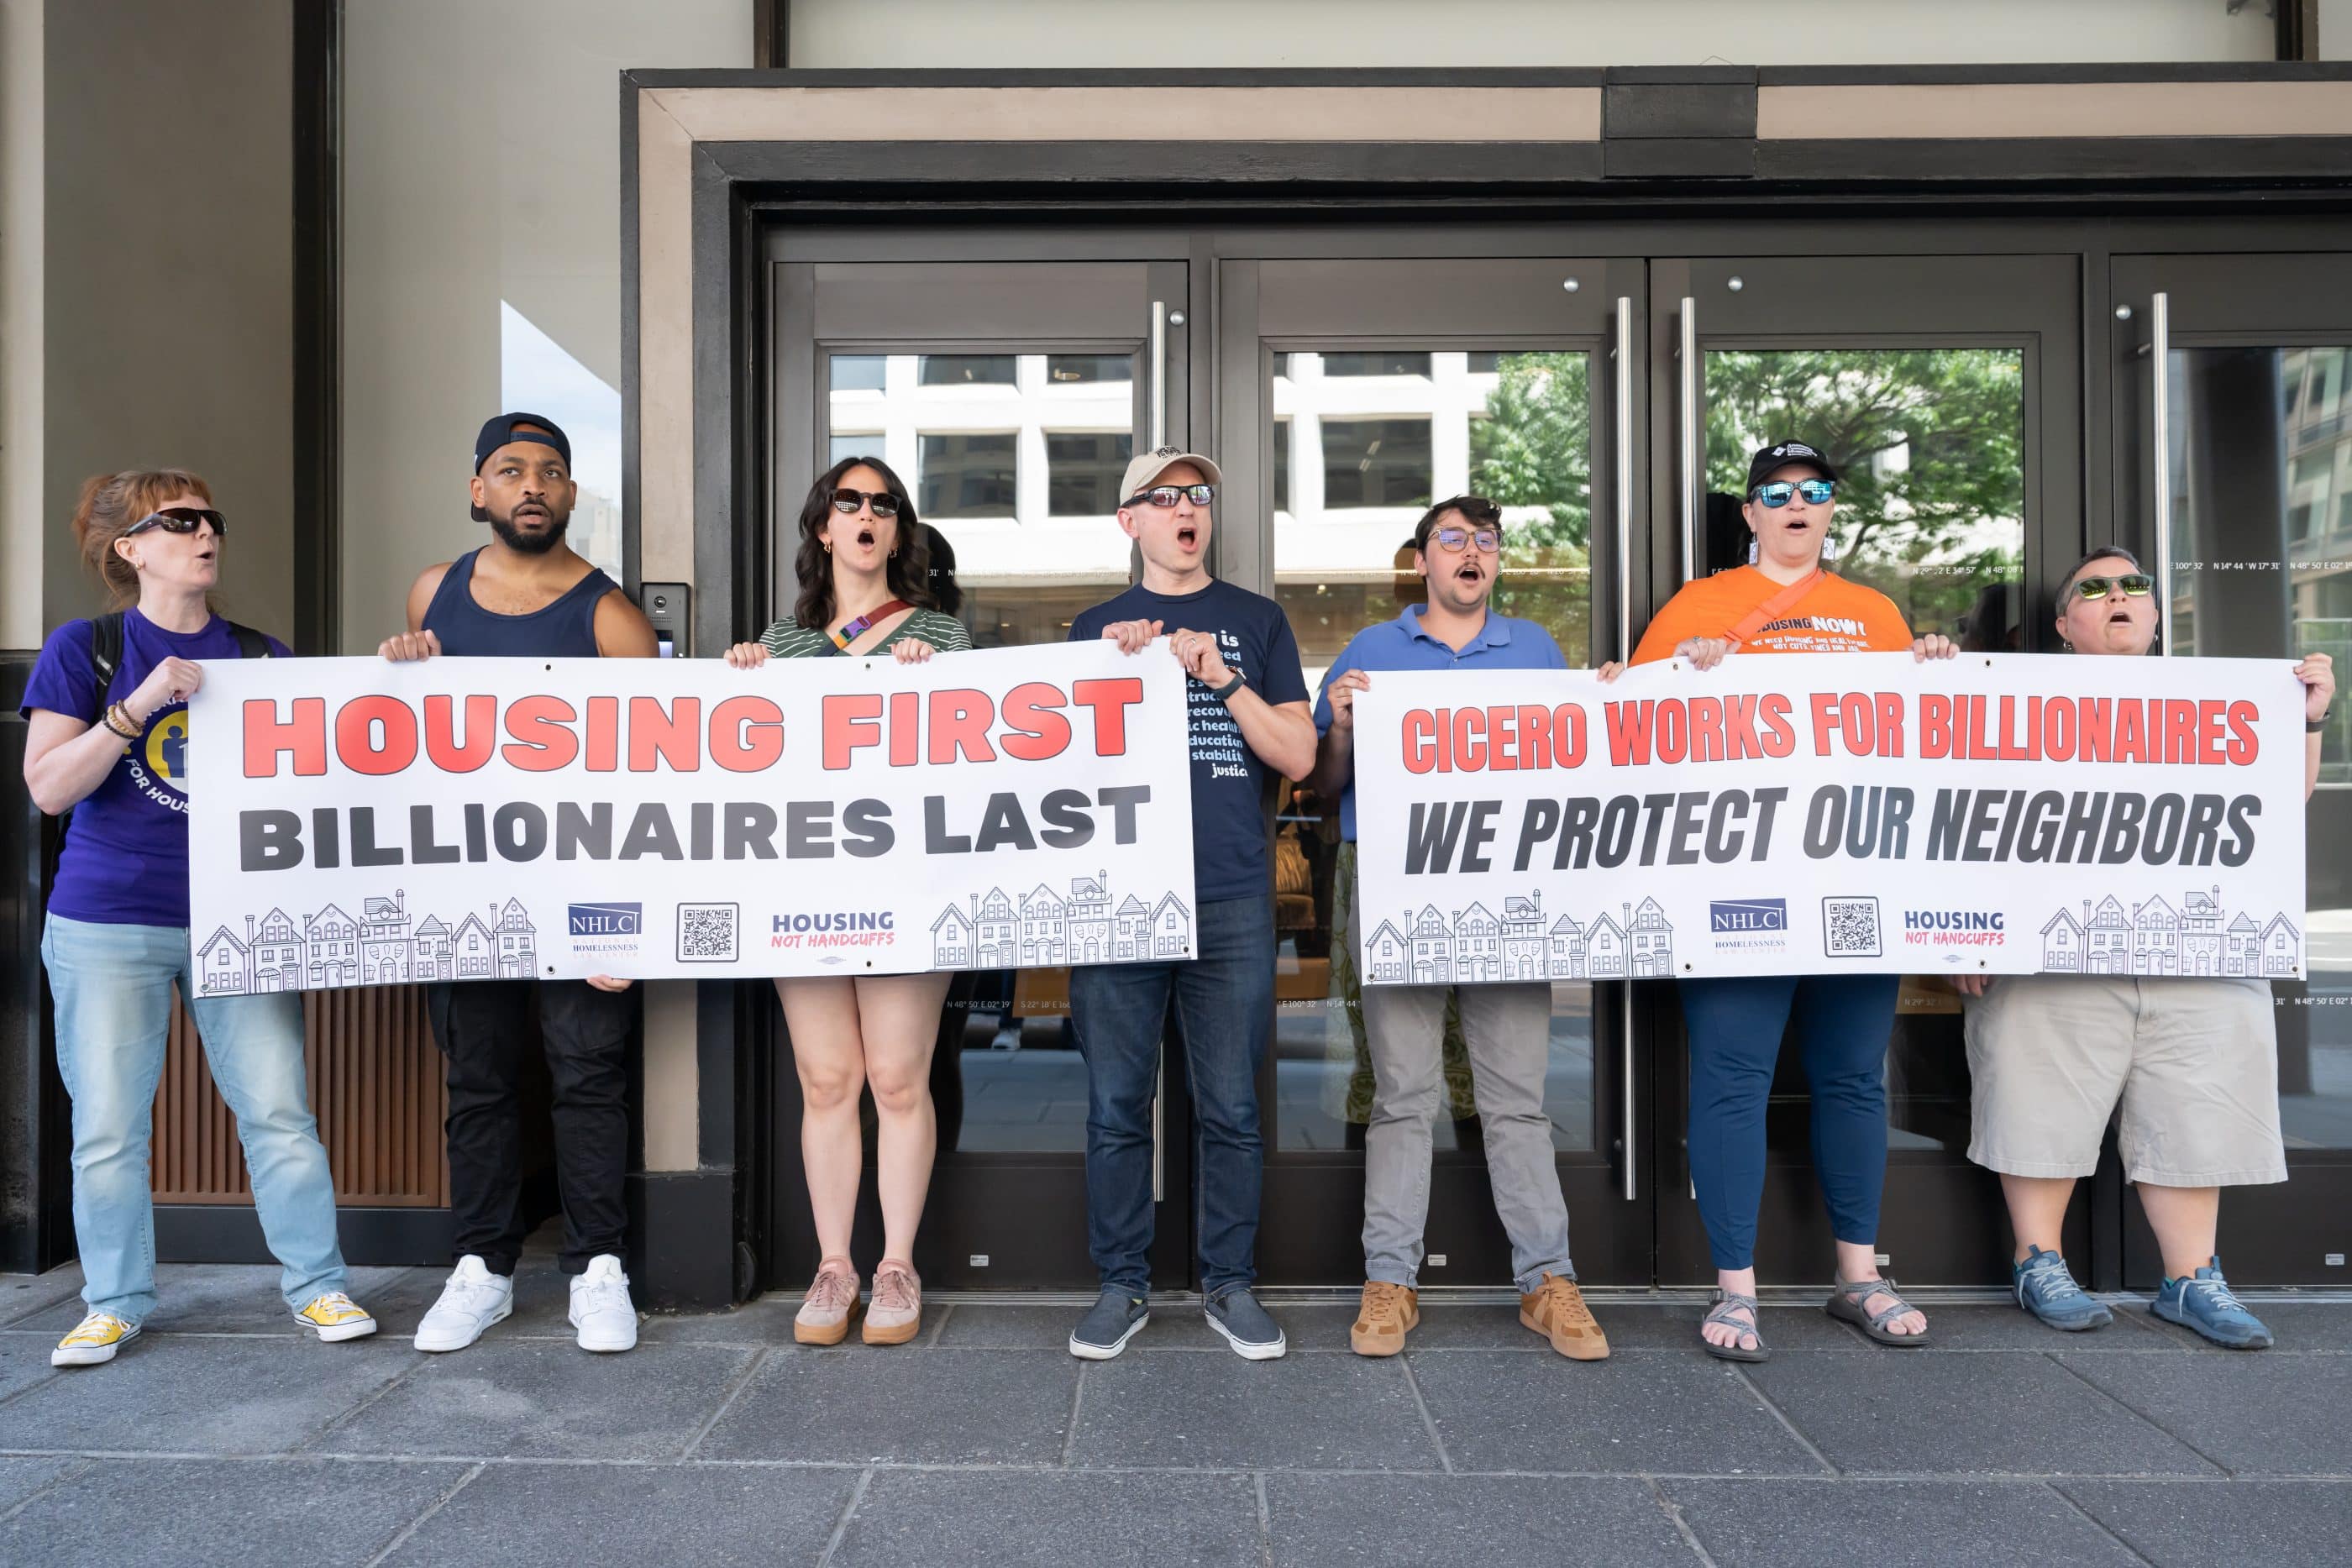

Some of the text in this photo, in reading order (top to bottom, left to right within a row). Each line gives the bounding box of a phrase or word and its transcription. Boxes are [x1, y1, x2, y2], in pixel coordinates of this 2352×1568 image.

[1811, 616, 1866, 636] NOW!
[1221, 630, 1239, 647] is
[243, 677, 1143, 778] HOUSING FIRST
[1402, 692, 2260, 774] CICERO WORKS FOR BILLIONAIRES
[1189, 734, 1242, 748] ducation
[1192, 749, 1244, 766] stabilit
[126, 758, 150, 789] FOR
[239, 784, 1151, 872] BILLIONAIRES LAST
[1404, 784, 2261, 875] WE PROTECT OUR NEIGHBORS
[571, 915, 633, 933] NHLC
[773, 911, 894, 932] HOUSING
[1714, 911, 1778, 930] NHLC
[1904, 910, 2004, 930] HOUSING
[573, 943, 638, 952] HOMELESSNESS
[771, 932, 895, 948] NOT HANDCUFFS
[1715, 940, 1786, 948] HOMELESSNESS
[1905, 931, 2005, 947] NOT HANDCUFFS
